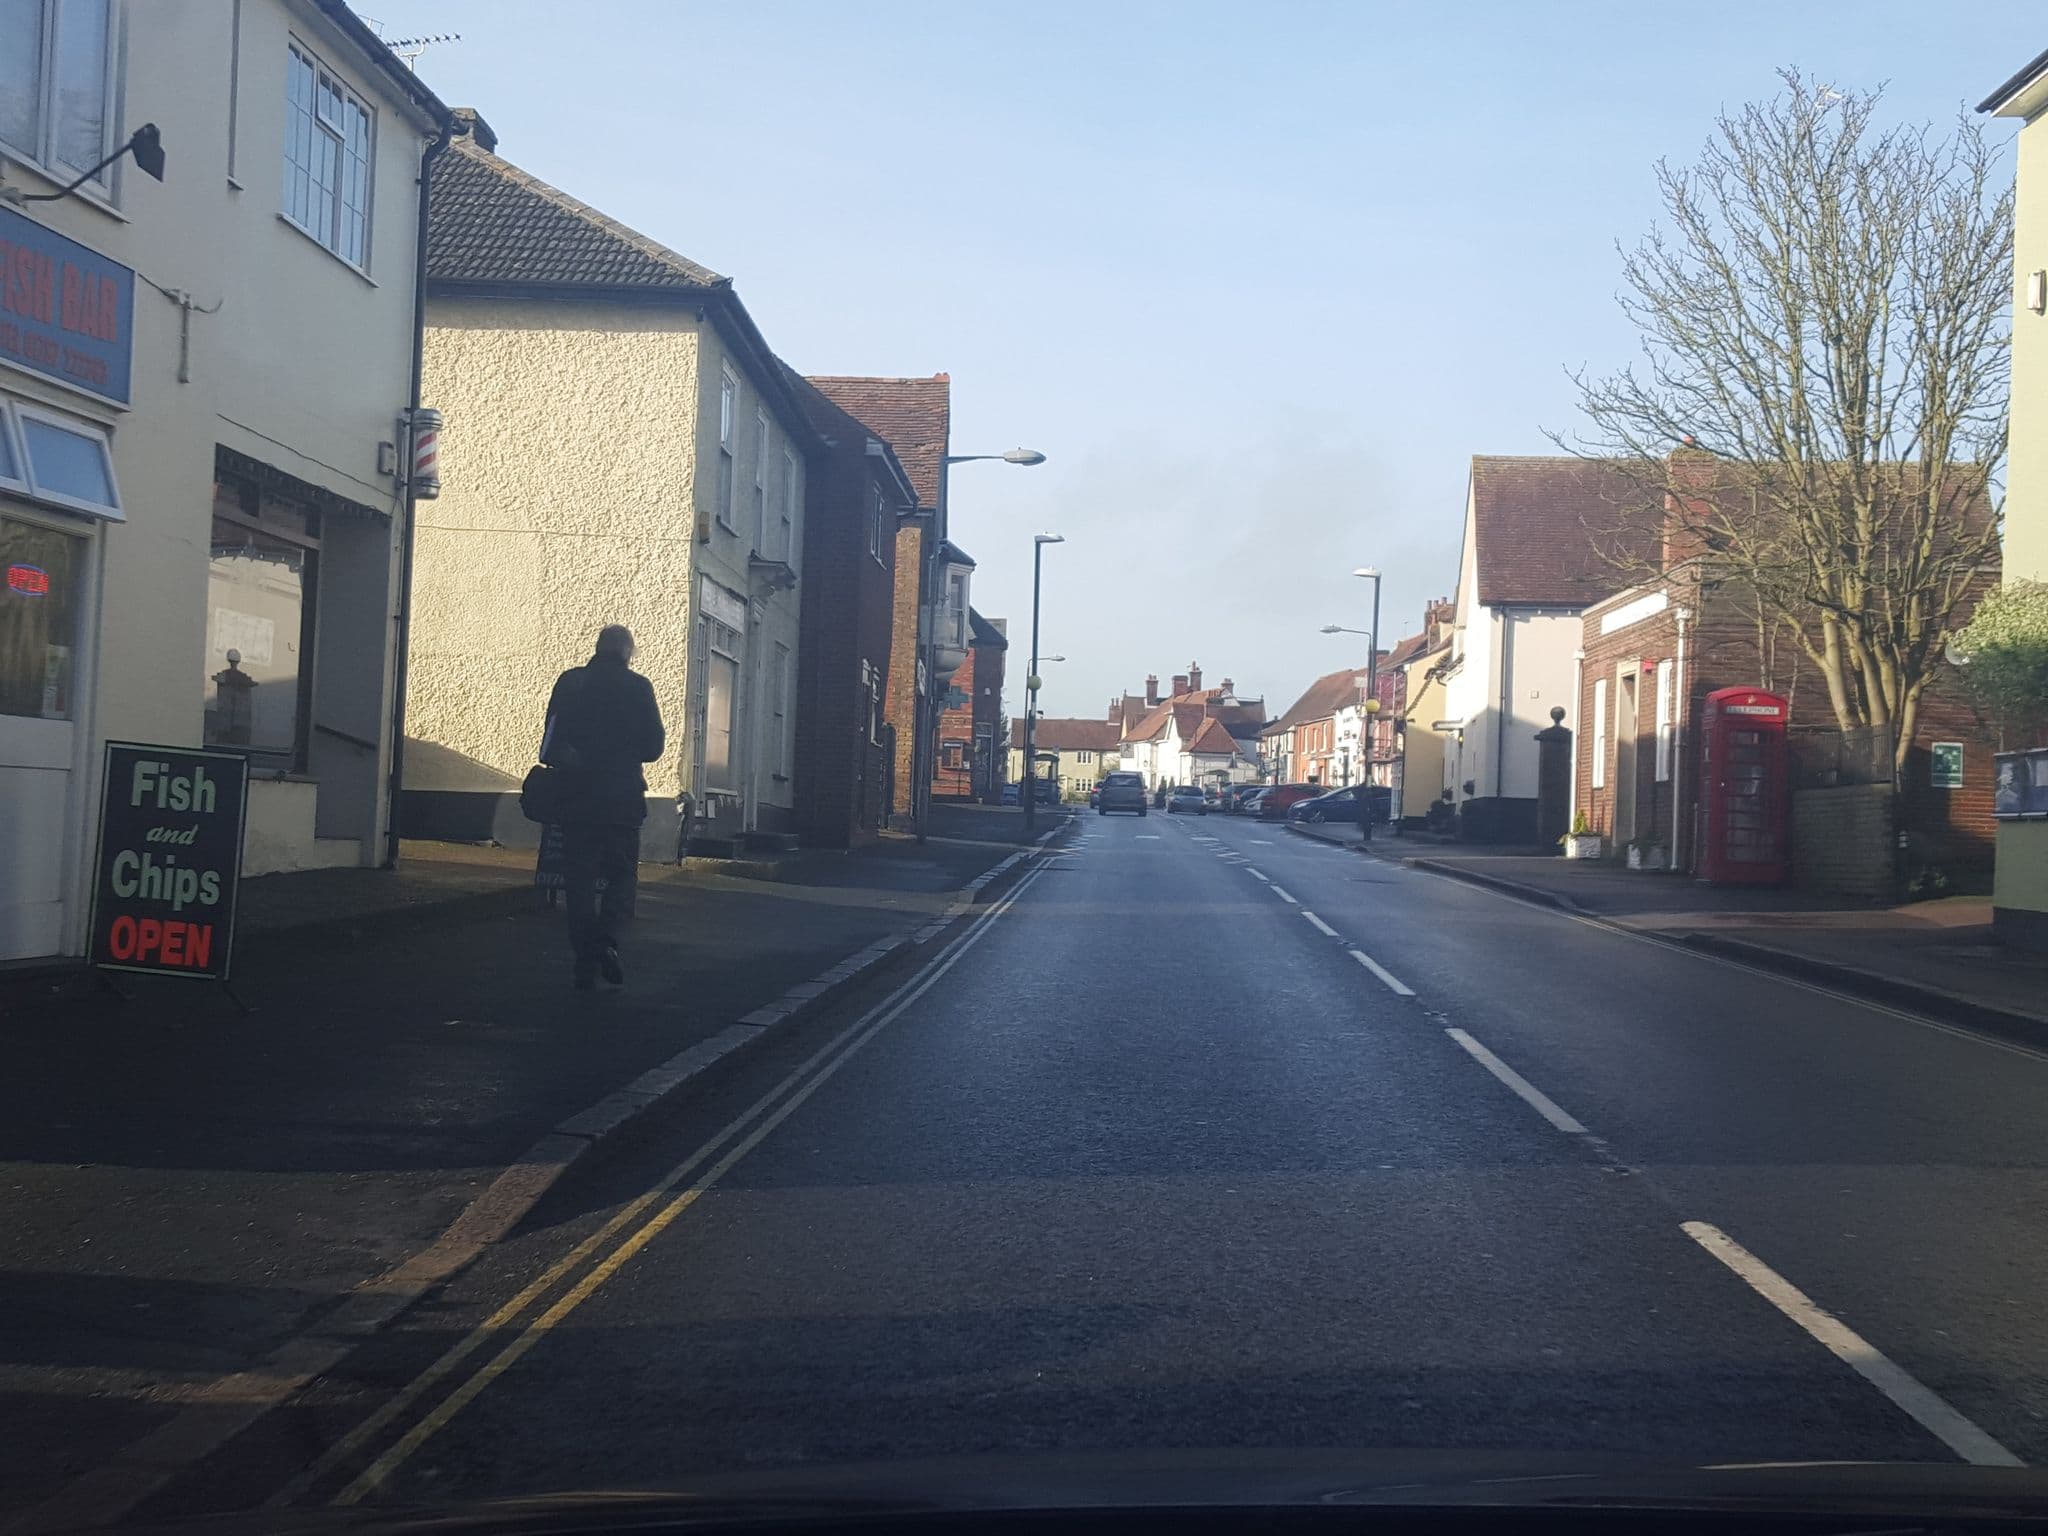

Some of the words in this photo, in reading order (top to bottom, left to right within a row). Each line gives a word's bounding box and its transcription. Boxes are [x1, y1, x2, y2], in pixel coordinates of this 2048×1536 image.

[61, 261, 118, 344] BAR
[8, 566, 49, 594] OPEN
[130, 760, 217, 813] Fish
[146, 824, 199, 846] and
[111, 849, 221, 912] Chips
[110, 915, 213, 968] OPEN
